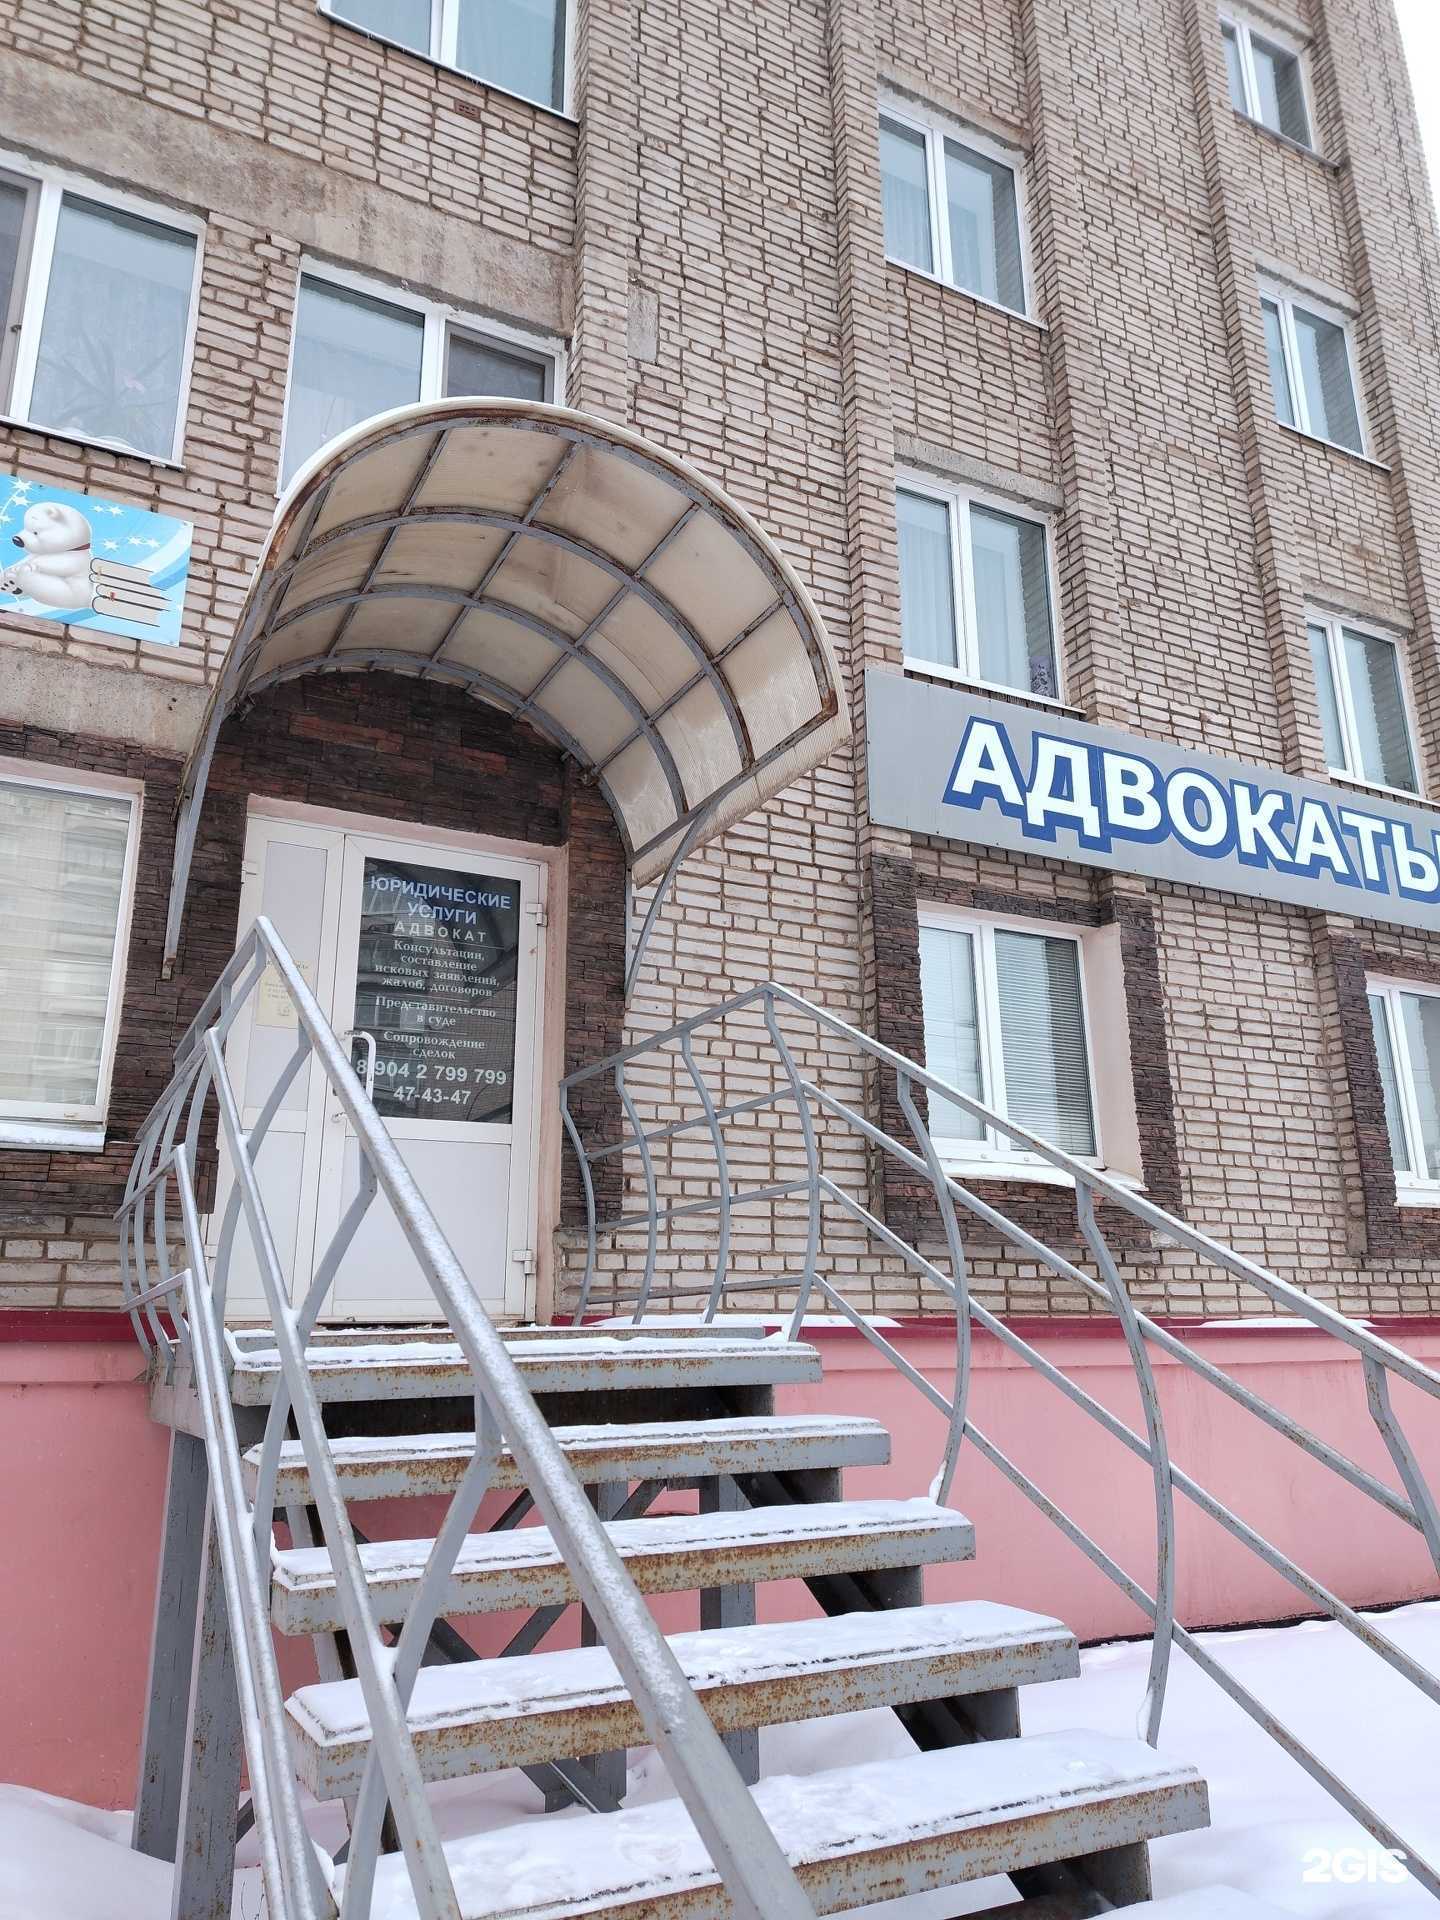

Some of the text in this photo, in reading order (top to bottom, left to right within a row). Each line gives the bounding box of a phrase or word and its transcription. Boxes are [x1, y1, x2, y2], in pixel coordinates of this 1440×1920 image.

[942, 715, 1440, 904] АДВОКАТЫ
[371, 876, 512, 909] ЮРИДИЧЕСКИЕ
[408, 902, 477, 925] УСЛУГИ
[394, 920, 486, 943] АДВОКАТ
[401, 954, 477, 972] составление
[375, 965, 500, 986] исковых заявлений,
[382, 977, 426, 990] жалоб,
[376, 996, 496, 1018] Представительство
[417, 1015, 456, 1026] в суде
[384, 1031, 485, 1050] Сопровождение
[413, 1048, 456, 1060] сделок
[416, 1064, 428, 1079] 2
[434, 1065, 468, 1082] 799
[474, 1068, 507, 1085] 799
[393, 1086, 472, 1105] 47-43-47
